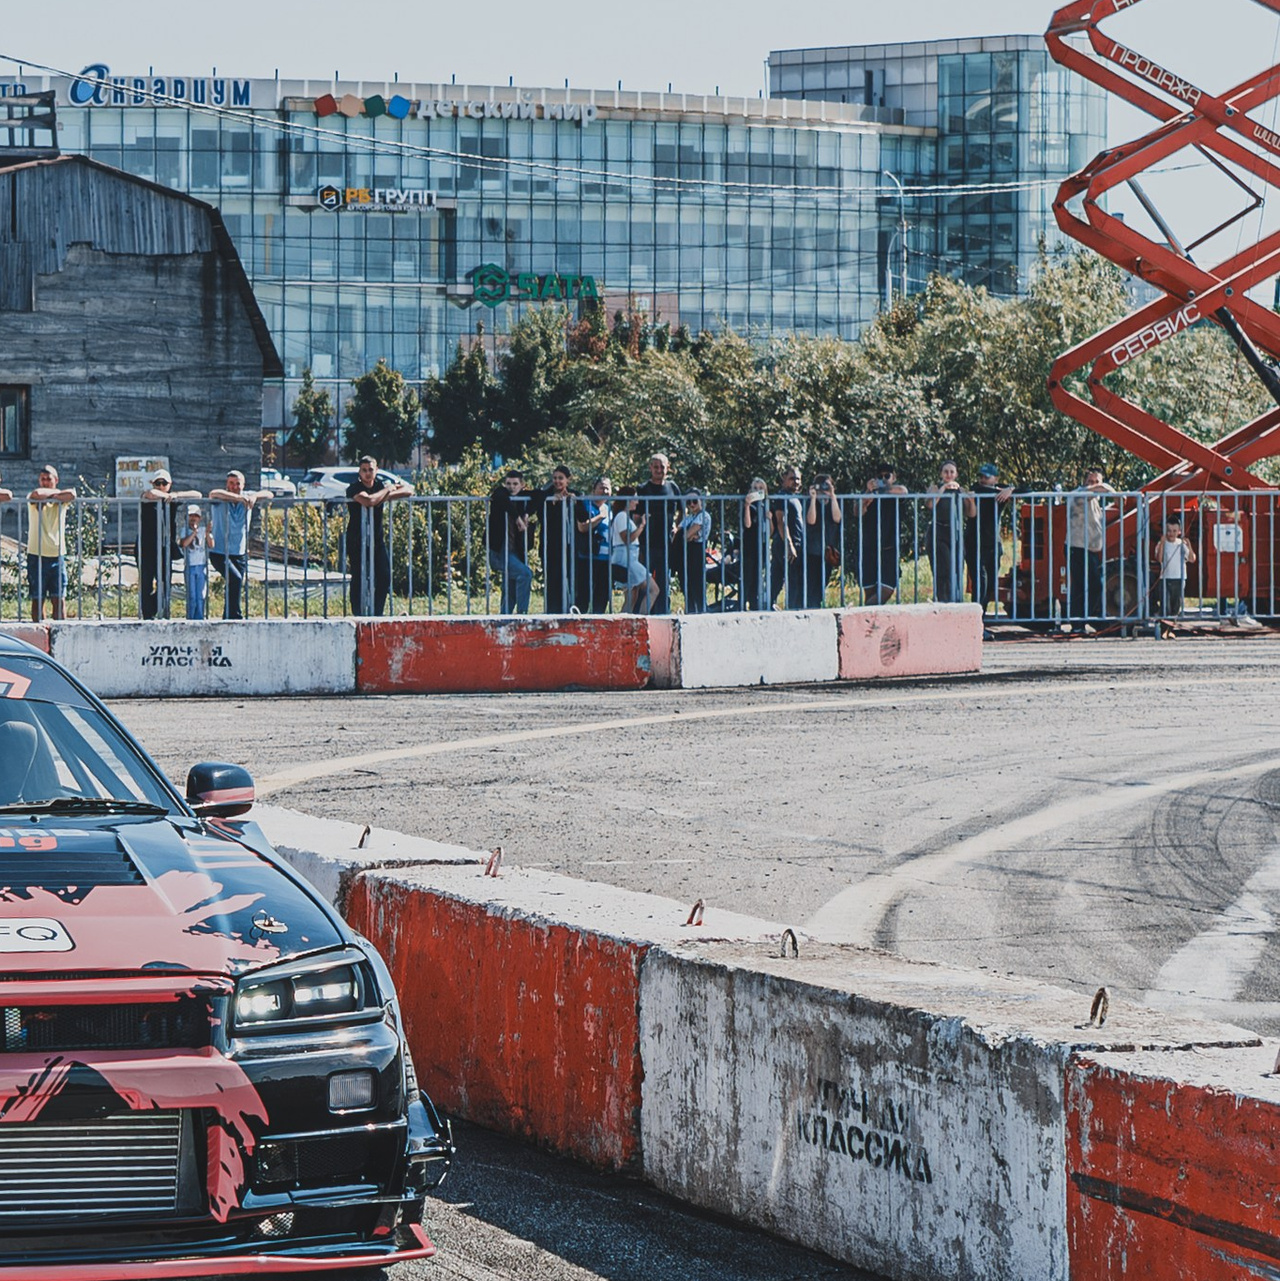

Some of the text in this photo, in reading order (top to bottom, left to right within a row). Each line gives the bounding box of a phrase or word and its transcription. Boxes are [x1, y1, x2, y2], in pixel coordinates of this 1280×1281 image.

[1109, 43, 1202, 105] ПРОДАЖА
[417, 91, 598, 128] детский мир
[345, 188, 437, 206] РБ ГРУПП
[1111, 303, 1201, 366] СЕРВИС
